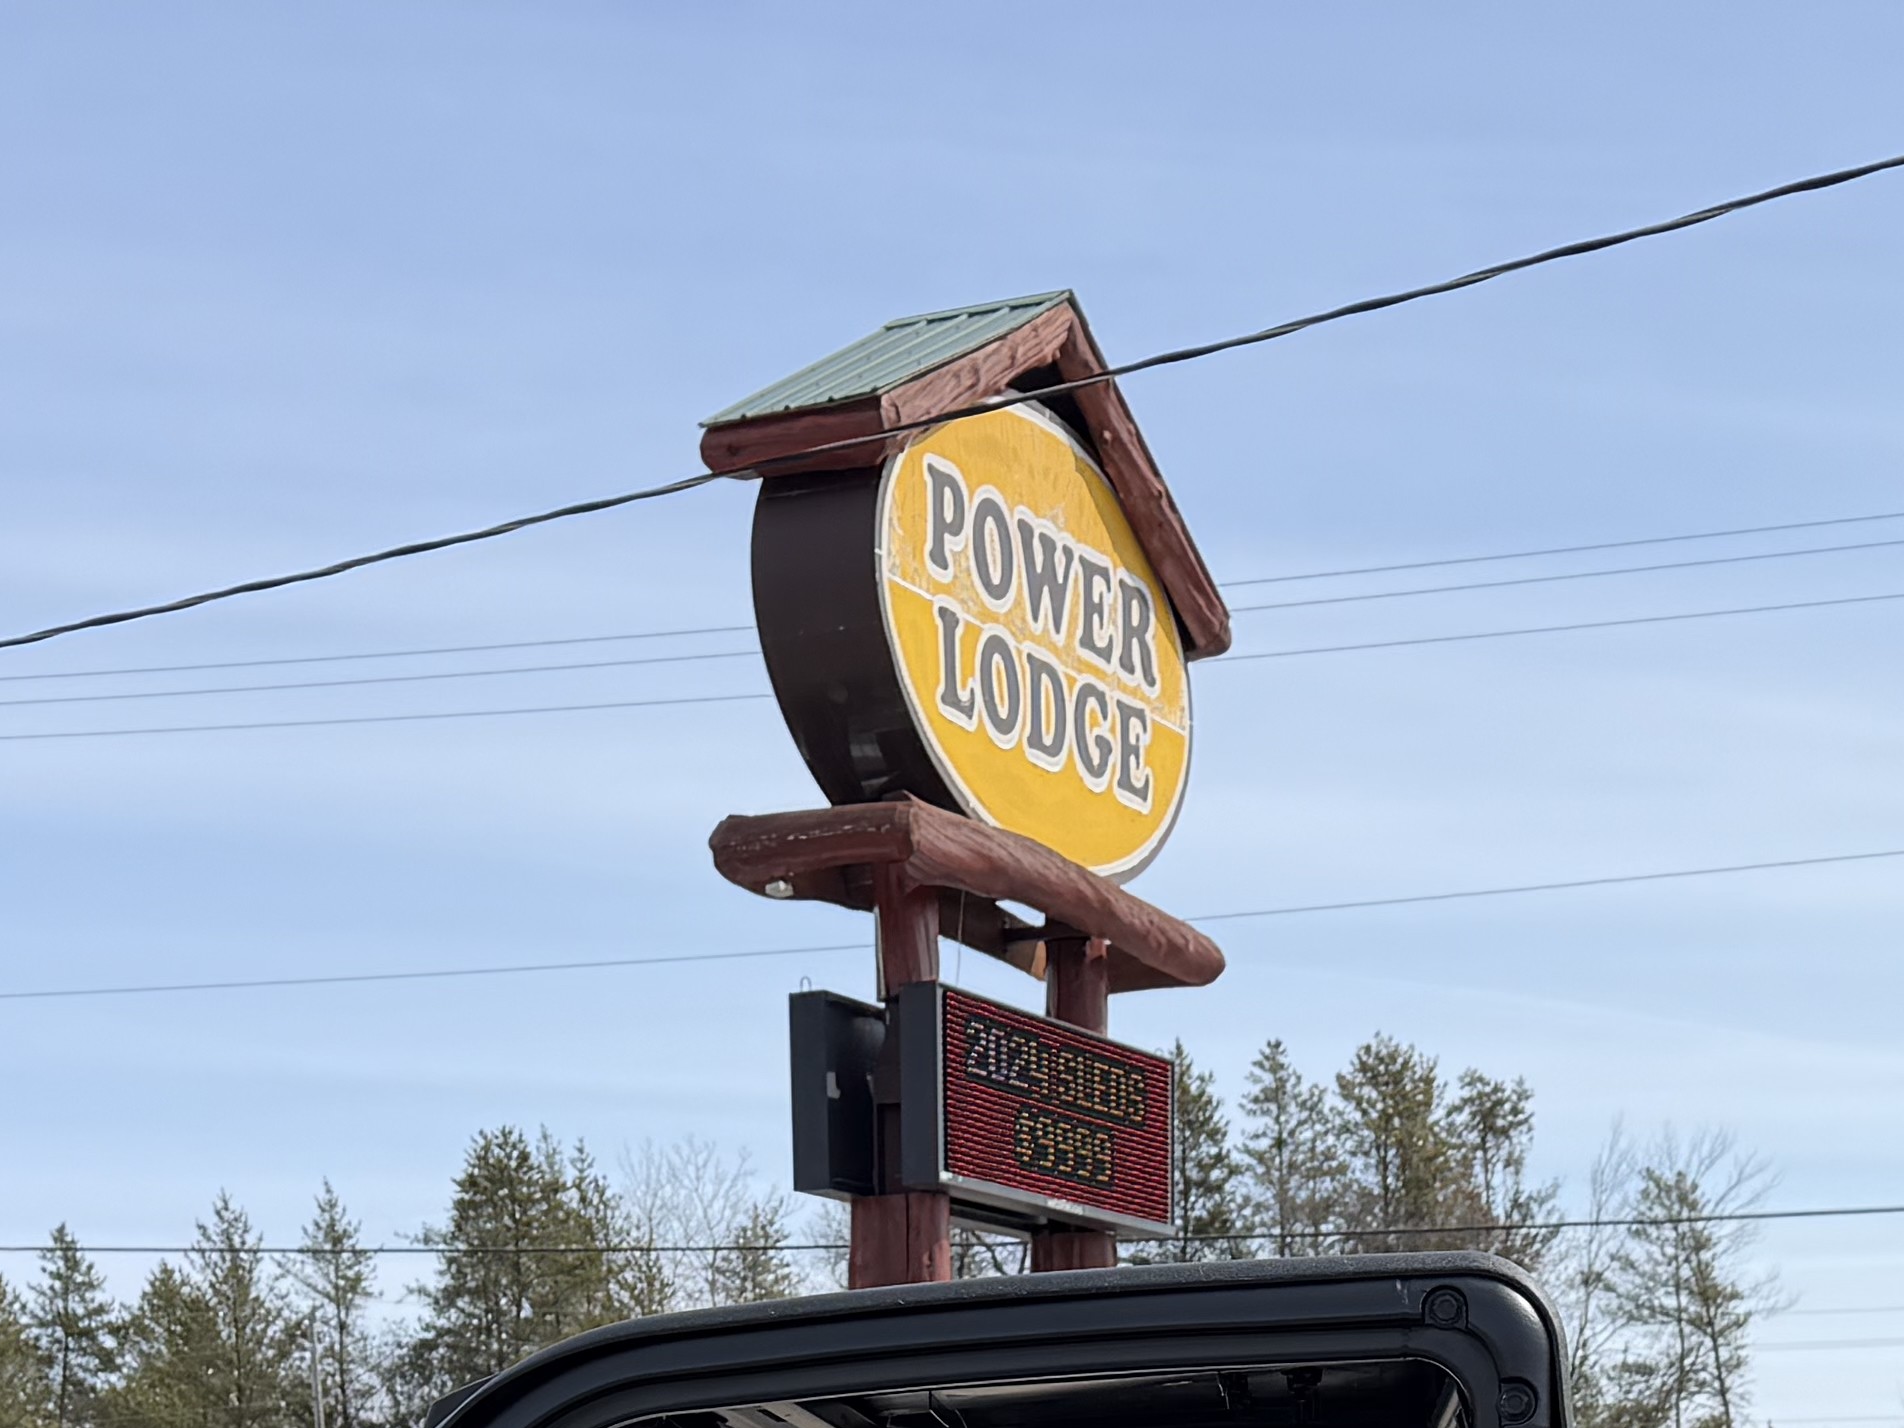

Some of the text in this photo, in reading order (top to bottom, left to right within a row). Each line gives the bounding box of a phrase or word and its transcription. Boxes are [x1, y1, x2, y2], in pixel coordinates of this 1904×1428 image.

[924, 458, 1159, 691] POWER
[934, 602, 1154, 809] LODGE
[966, 1021, 1049, 1094] 2024
